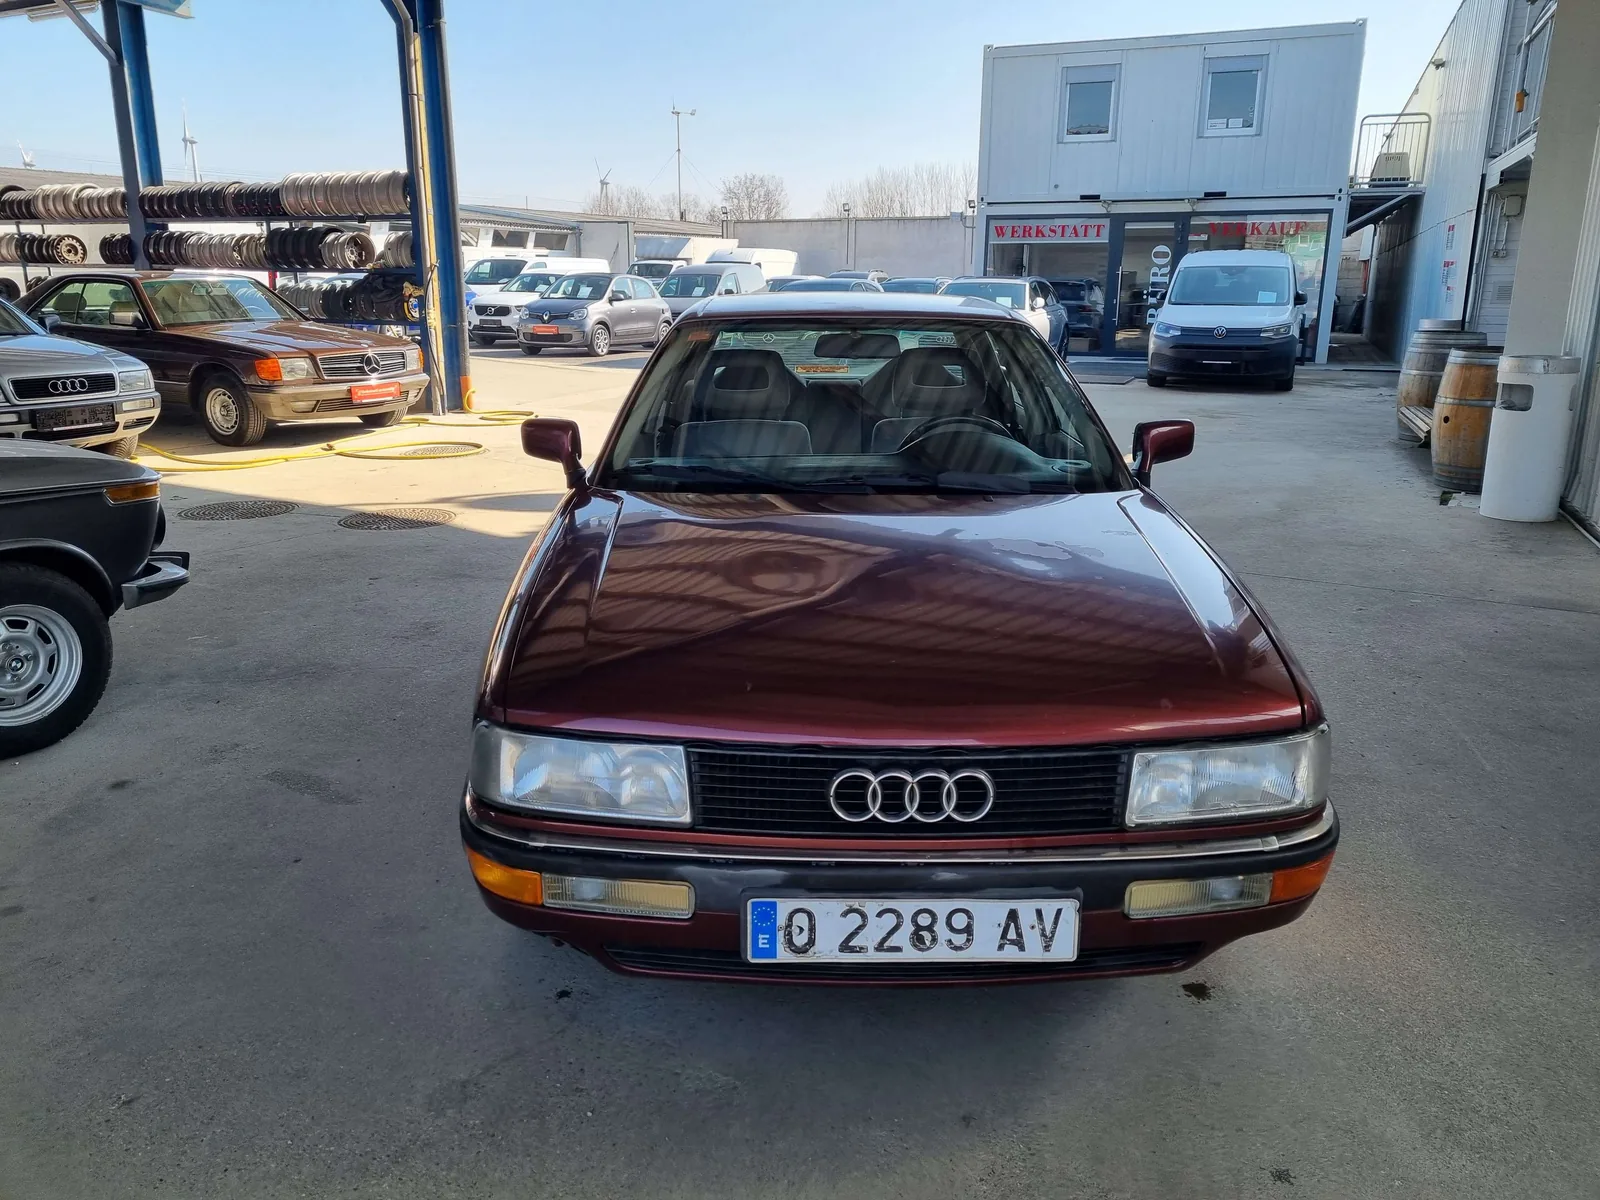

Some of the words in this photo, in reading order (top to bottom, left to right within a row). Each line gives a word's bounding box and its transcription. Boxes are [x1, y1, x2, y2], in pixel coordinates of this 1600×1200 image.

[994, 224, 1106, 239] WERKSTATT
[1208, 221, 1307, 236] VERKAUF
[838, 907, 975, 953] 2289
[996, 908, 1063, 953] AV
[758, 933, 770, 948] E
